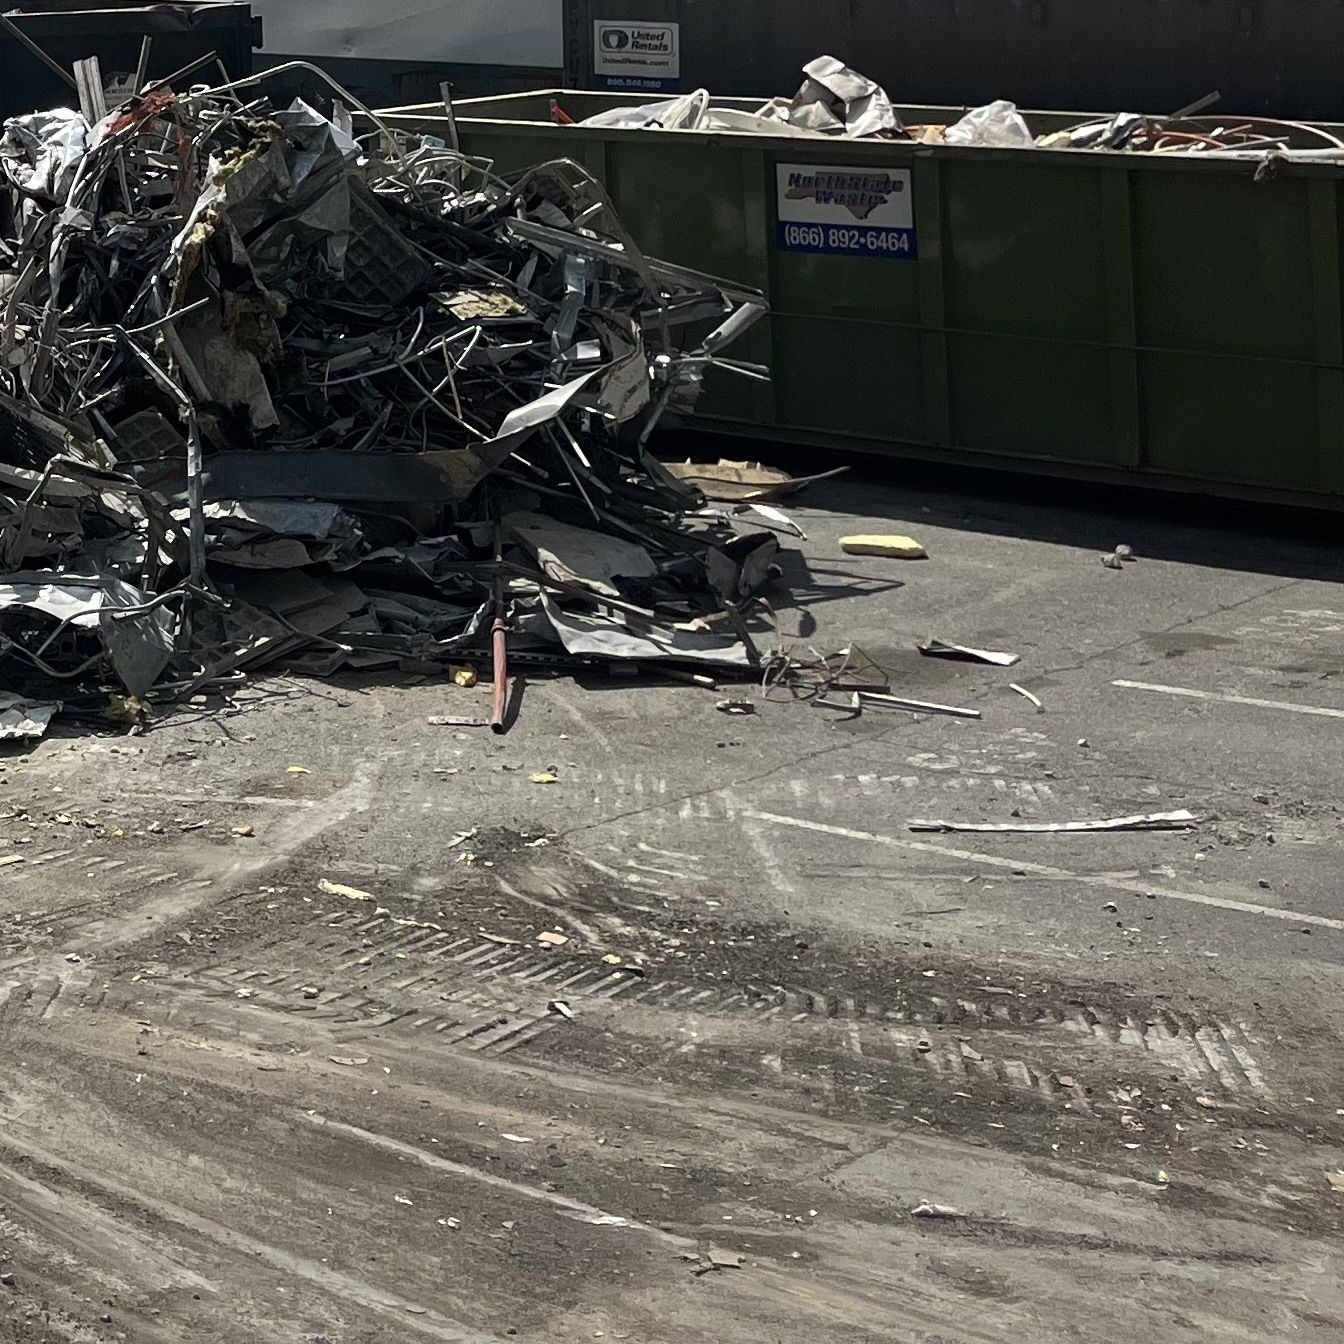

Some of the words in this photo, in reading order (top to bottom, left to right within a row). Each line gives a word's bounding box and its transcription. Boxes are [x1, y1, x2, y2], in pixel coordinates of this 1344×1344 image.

[631, 30, 666, 41] United
[631, 41, 669, 52] Rentals
[784, 224, 824, 248] (866)
